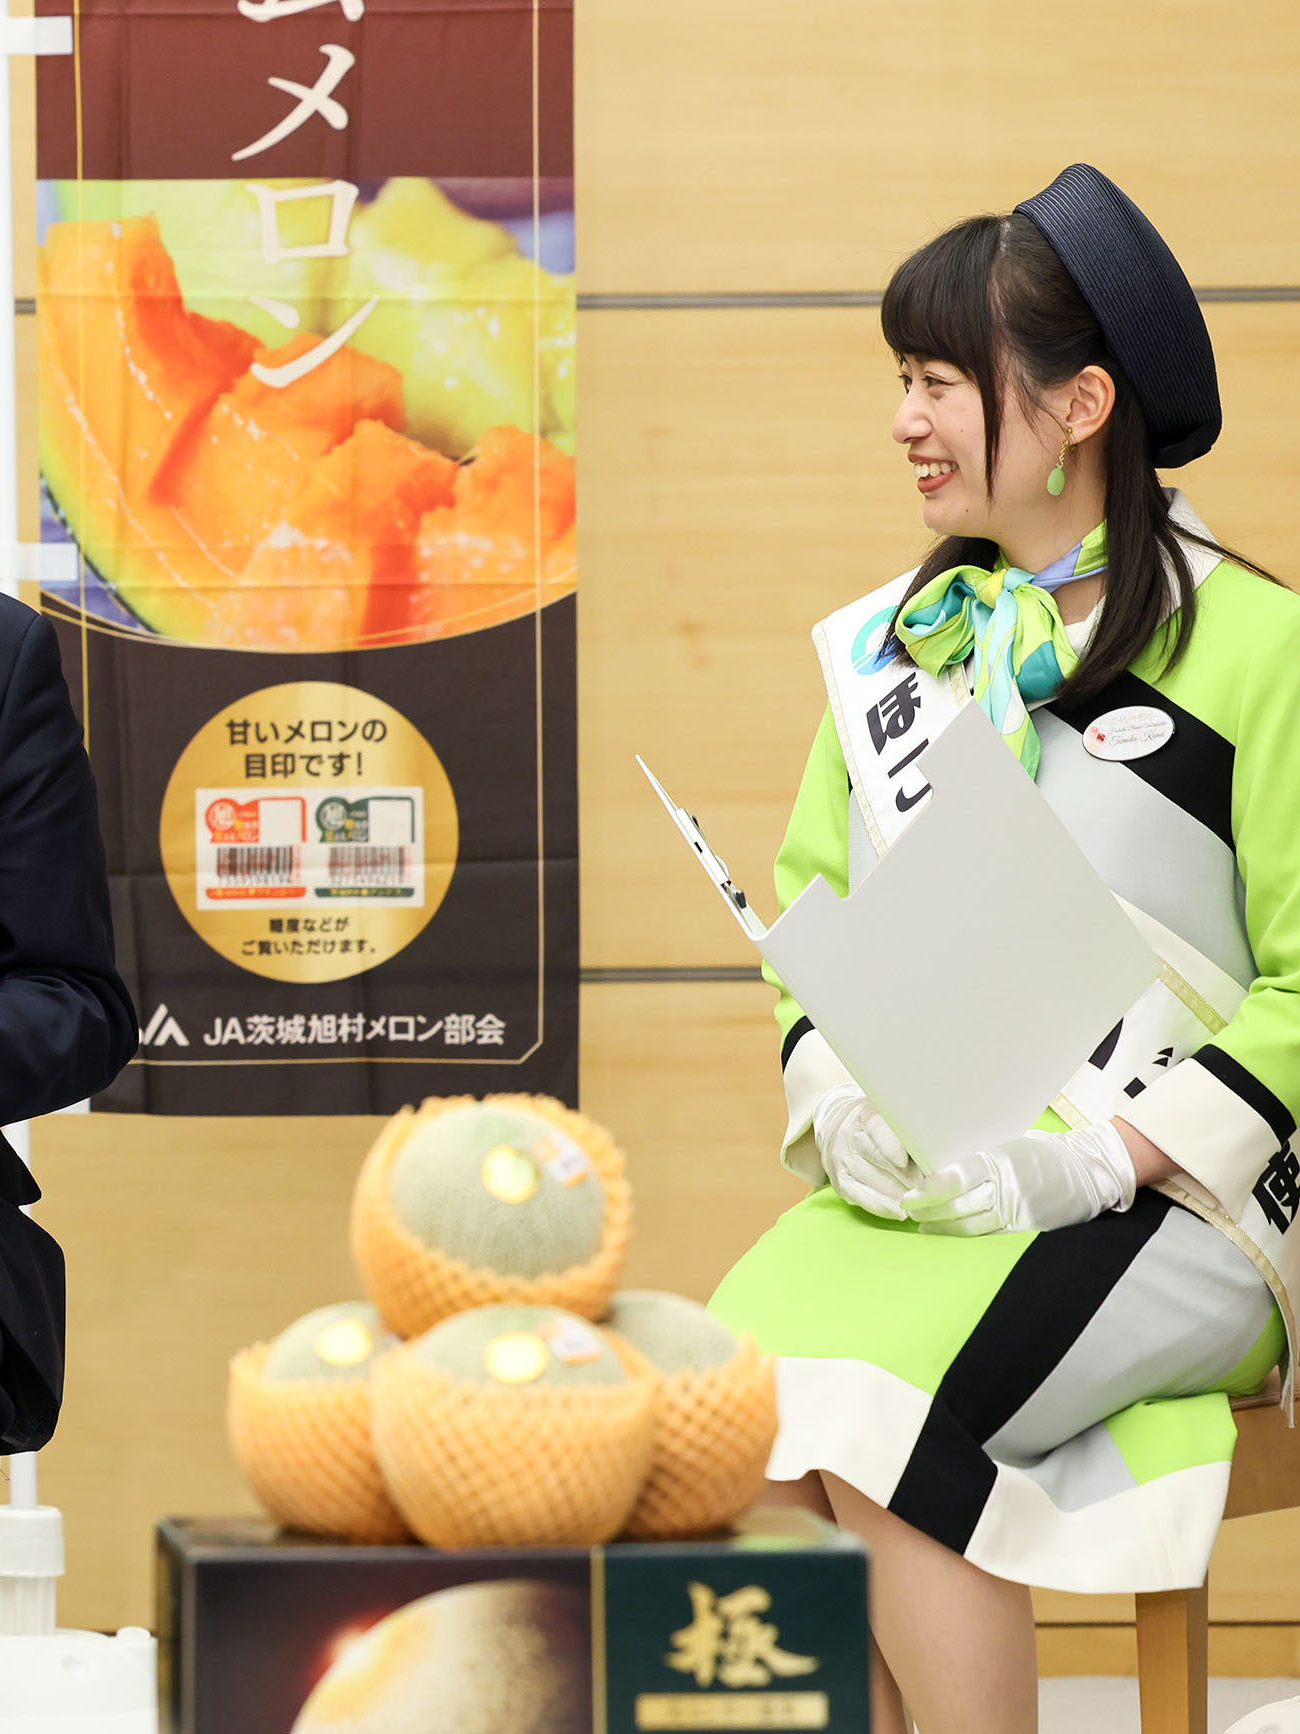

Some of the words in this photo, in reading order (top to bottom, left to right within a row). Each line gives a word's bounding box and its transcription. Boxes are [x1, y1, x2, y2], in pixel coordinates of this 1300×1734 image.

[225, 719, 387, 745] 甘いメロンの
[241, 939, 376, 955] ご覧いただけます。
[204, 1012, 506, 1046] JA茨城旭村メロン部会
